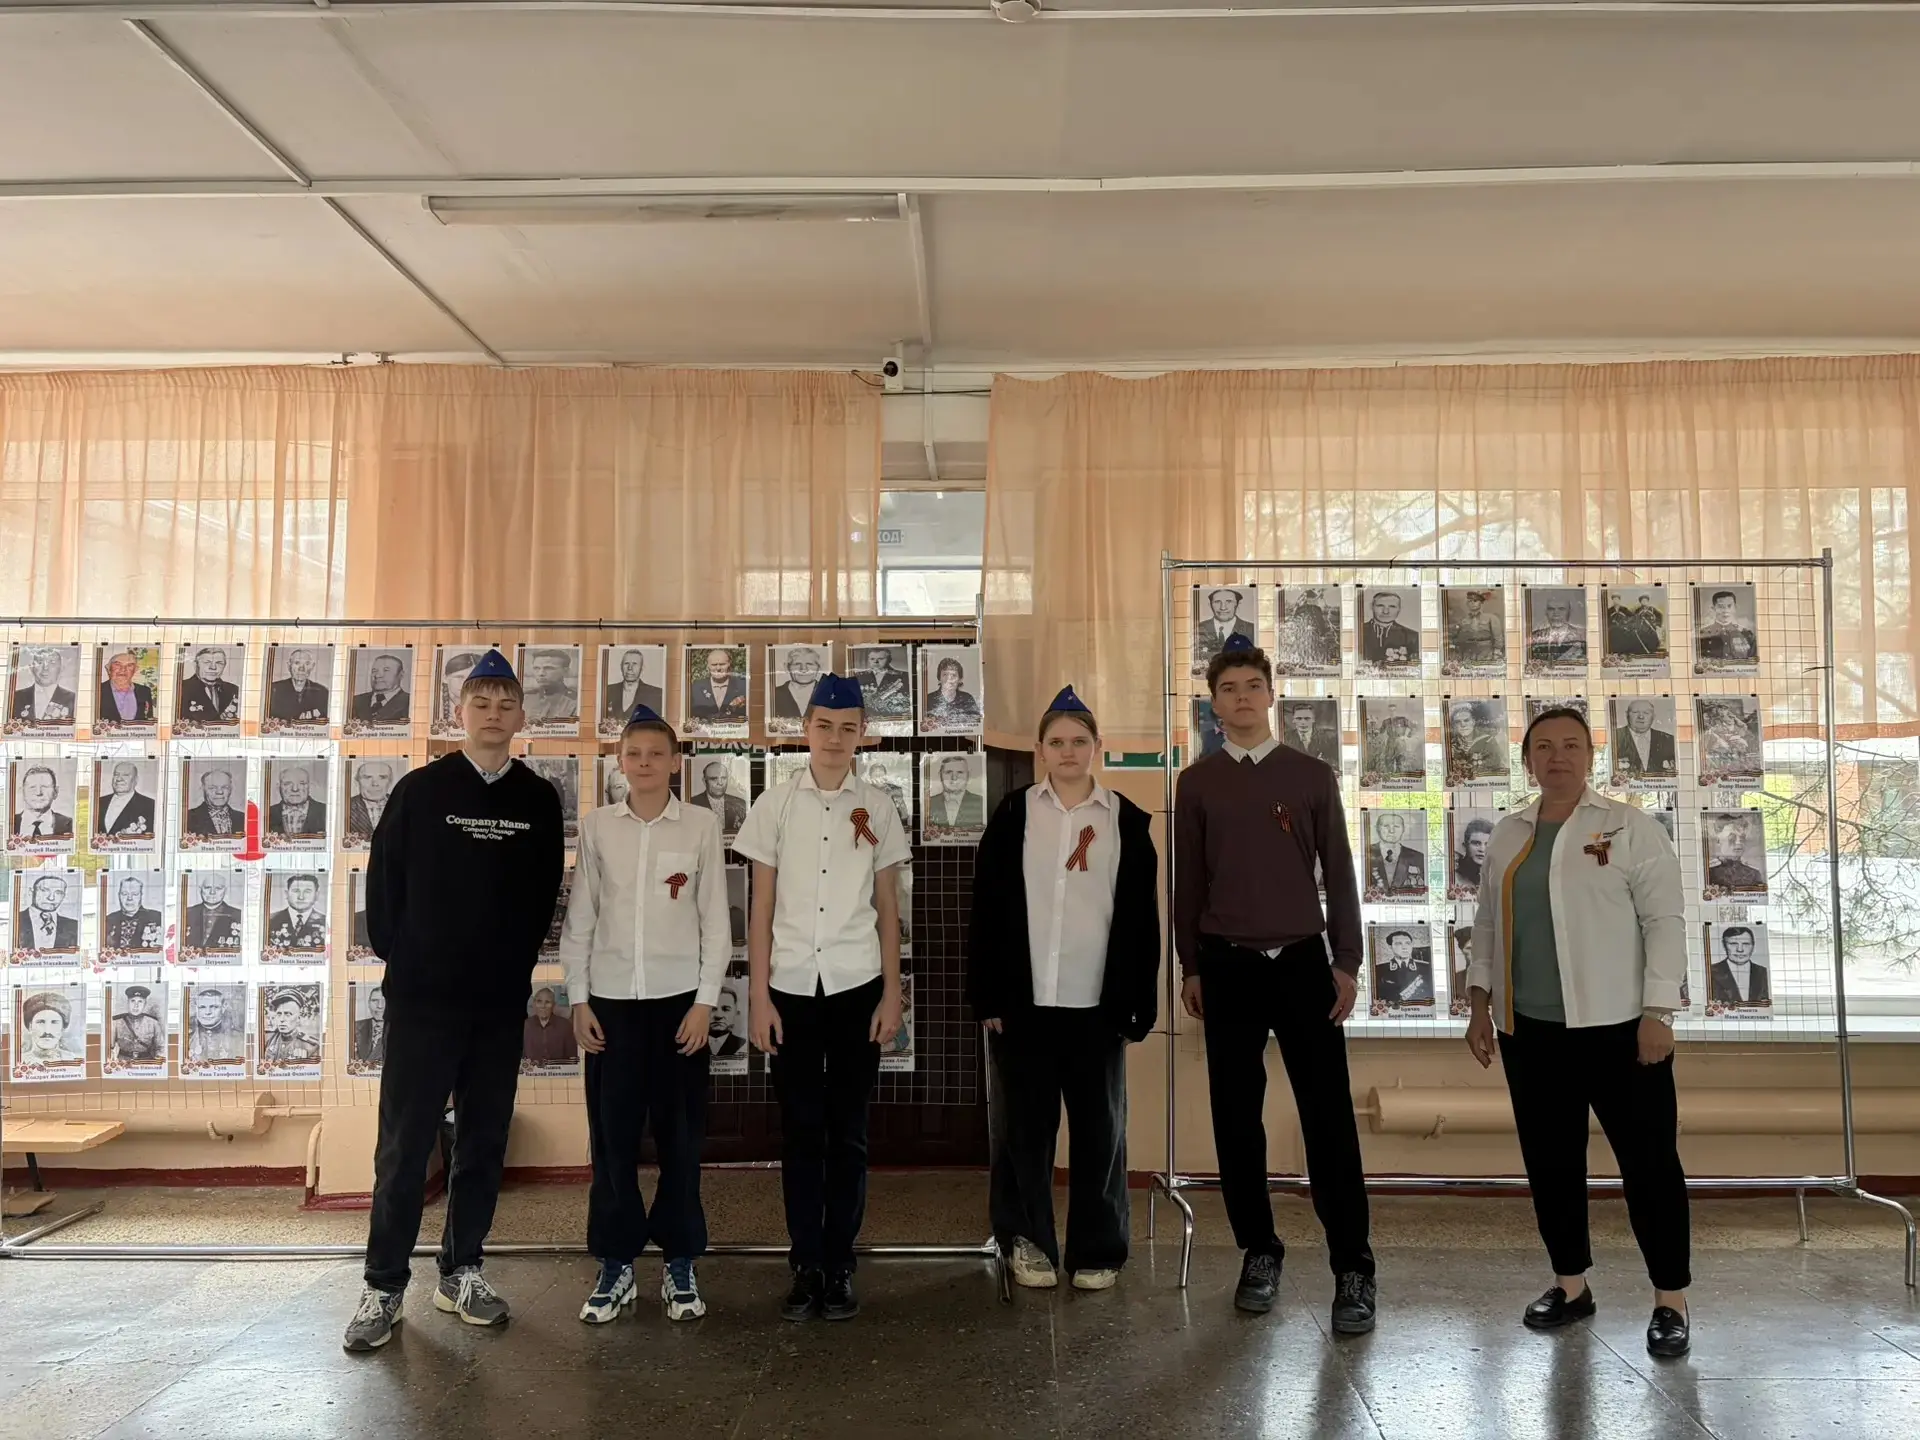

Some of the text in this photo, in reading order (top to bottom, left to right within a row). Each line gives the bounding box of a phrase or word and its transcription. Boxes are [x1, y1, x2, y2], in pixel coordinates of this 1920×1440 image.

[446, 815, 531, 831] Company Name
[462, 826, 489, 834] Company
